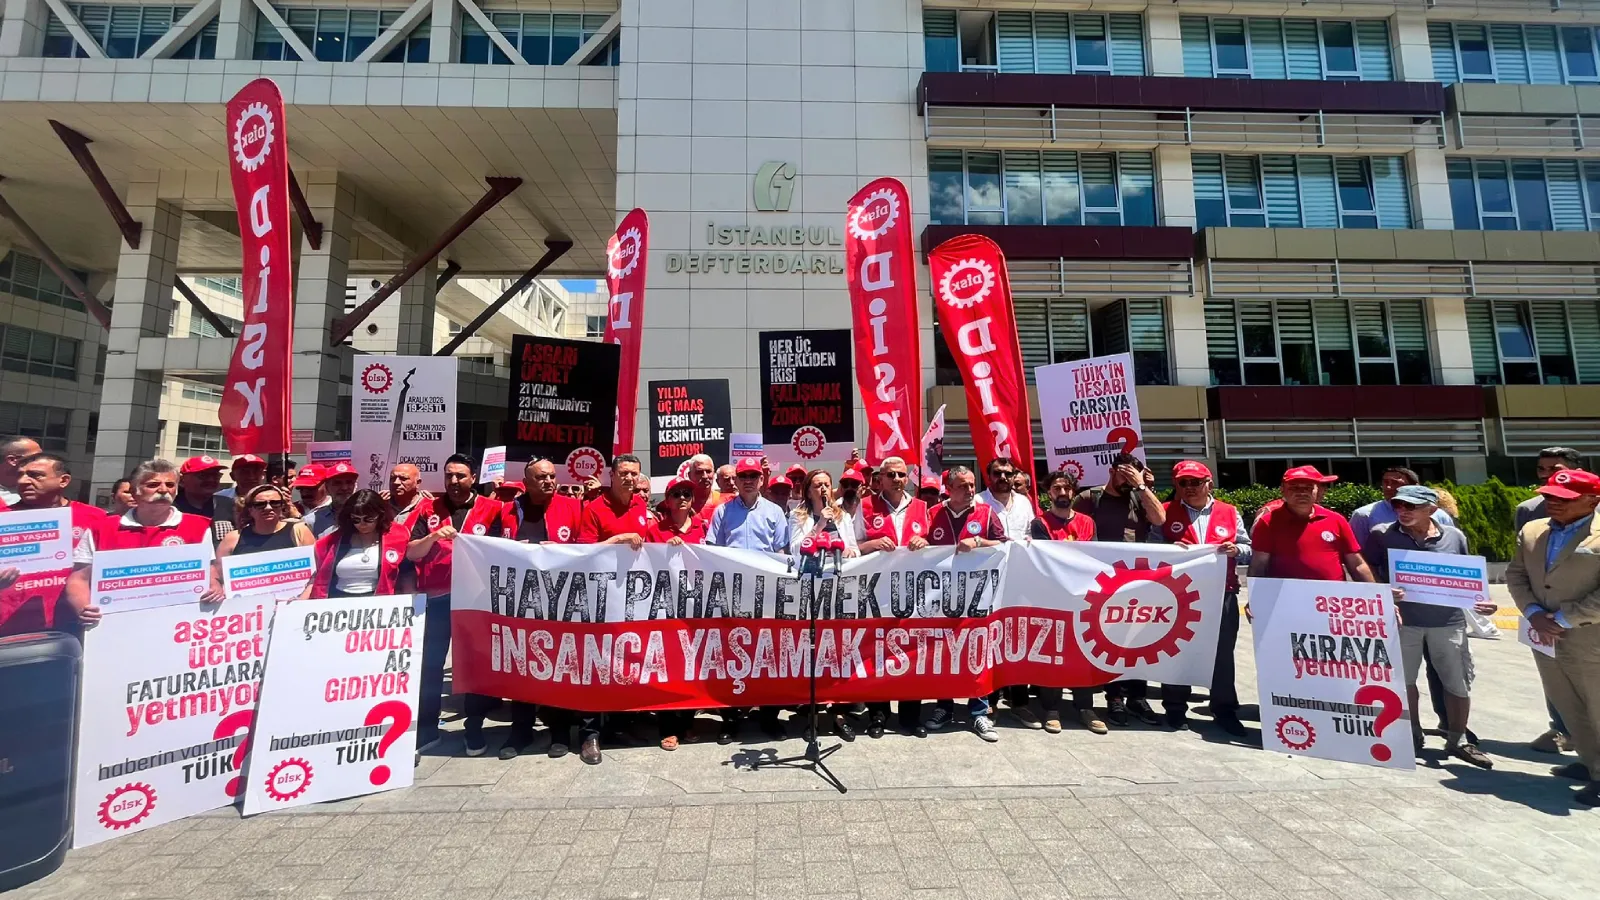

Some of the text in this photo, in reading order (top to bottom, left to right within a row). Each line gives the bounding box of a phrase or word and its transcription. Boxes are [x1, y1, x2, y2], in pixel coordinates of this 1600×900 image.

[707, 221, 843, 246] İSTANBUL
[666, 253, 844, 274] DEFTERDARL
[522, 343, 579, 366] ASGARİ
[769, 335, 812, 357] HER ÜÇ
[770, 352, 837, 368] EMEKLİDEN
[368, 373, 387, 382] DİSK
[521, 362, 572, 385] ÜCRET
[770, 367, 797, 383] İKİSİ
[519, 382, 558, 397] 21 YILDA
[657, 386, 688, 400] YILDA
[1074, 378, 1127, 399] HESABI
[519, 396, 592, 413] 23 CUMHURİYET
[657, 398, 704, 415] ÜÇ MAAŞ
[771, 405, 842, 426] ZORUNDA!
[1069, 394, 1131, 418] ÇARŞIYA
[657, 413, 705, 428] VERGİ VE
[1061, 410, 1132, 433] UYMUYOR
[658, 427, 725, 443] KESİNTİLERE
[800, 438, 818, 447] DİSK
[658, 442, 704, 458] GİDİYOR!
[575, 460, 596, 470] DİSK
[2, 532, 56, 543] BİR YAŞAM
[165, 561, 199, 570] ADALET
[232, 559, 308, 576] GELİRDE ADALET!
[1398, 562, 1478, 577] GELİRDE ADALET!
[101, 572, 202, 590] İŞÇİLERLE GELECEK!
[233, 571, 309, 589] VERGİDE ADALET!
[1398, 574, 1479, 589] VERGİDE ADALET!
[490, 565, 617, 623] HAYAT
[625, 569, 765, 621] PAHALI
[775, 572, 882, 621] EMEK
[1104, 598, 1173, 624] DİSK
[1315, 593, 1384, 619] asgari
[173, 604, 263, 644] asgari
[303, 606, 415, 641] ÇOCUKLAR
[1328, 613, 1388, 639] ücret
[188, 633, 264, 670] ücret
[345, 627, 413, 654] OKULA
[1290, 632, 1392, 669] KİRAYA
[384, 648, 412, 676] AÇ
[491, 616, 1066, 695] İNSANCA YAŞAMAK İSTİYORUZ!
[126, 659, 265, 705] FATURALARA
[1292, 656, 1394, 686] yetmiyor
[325, 672, 410, 703] GİDİYOR
[1271, 692, 1325, 712] haberin
[1328, 702, 1353, 714] var
[1285, 727, 1306, 737] DİSK
[1332, 714, 1375, 738] TÜİK
[269, 729, 331, 752] haberin
[336, 727, 361, 742] var
[98, 751, 174, 781] haberin
[180, 742, 210, 760] var
[336, 738, 379, 766] TÜİK
[182, 752, 233, 784] TÜİK
[277, 772, 302, 784] DİSK
[113, 798, 143, 814] DİSK
